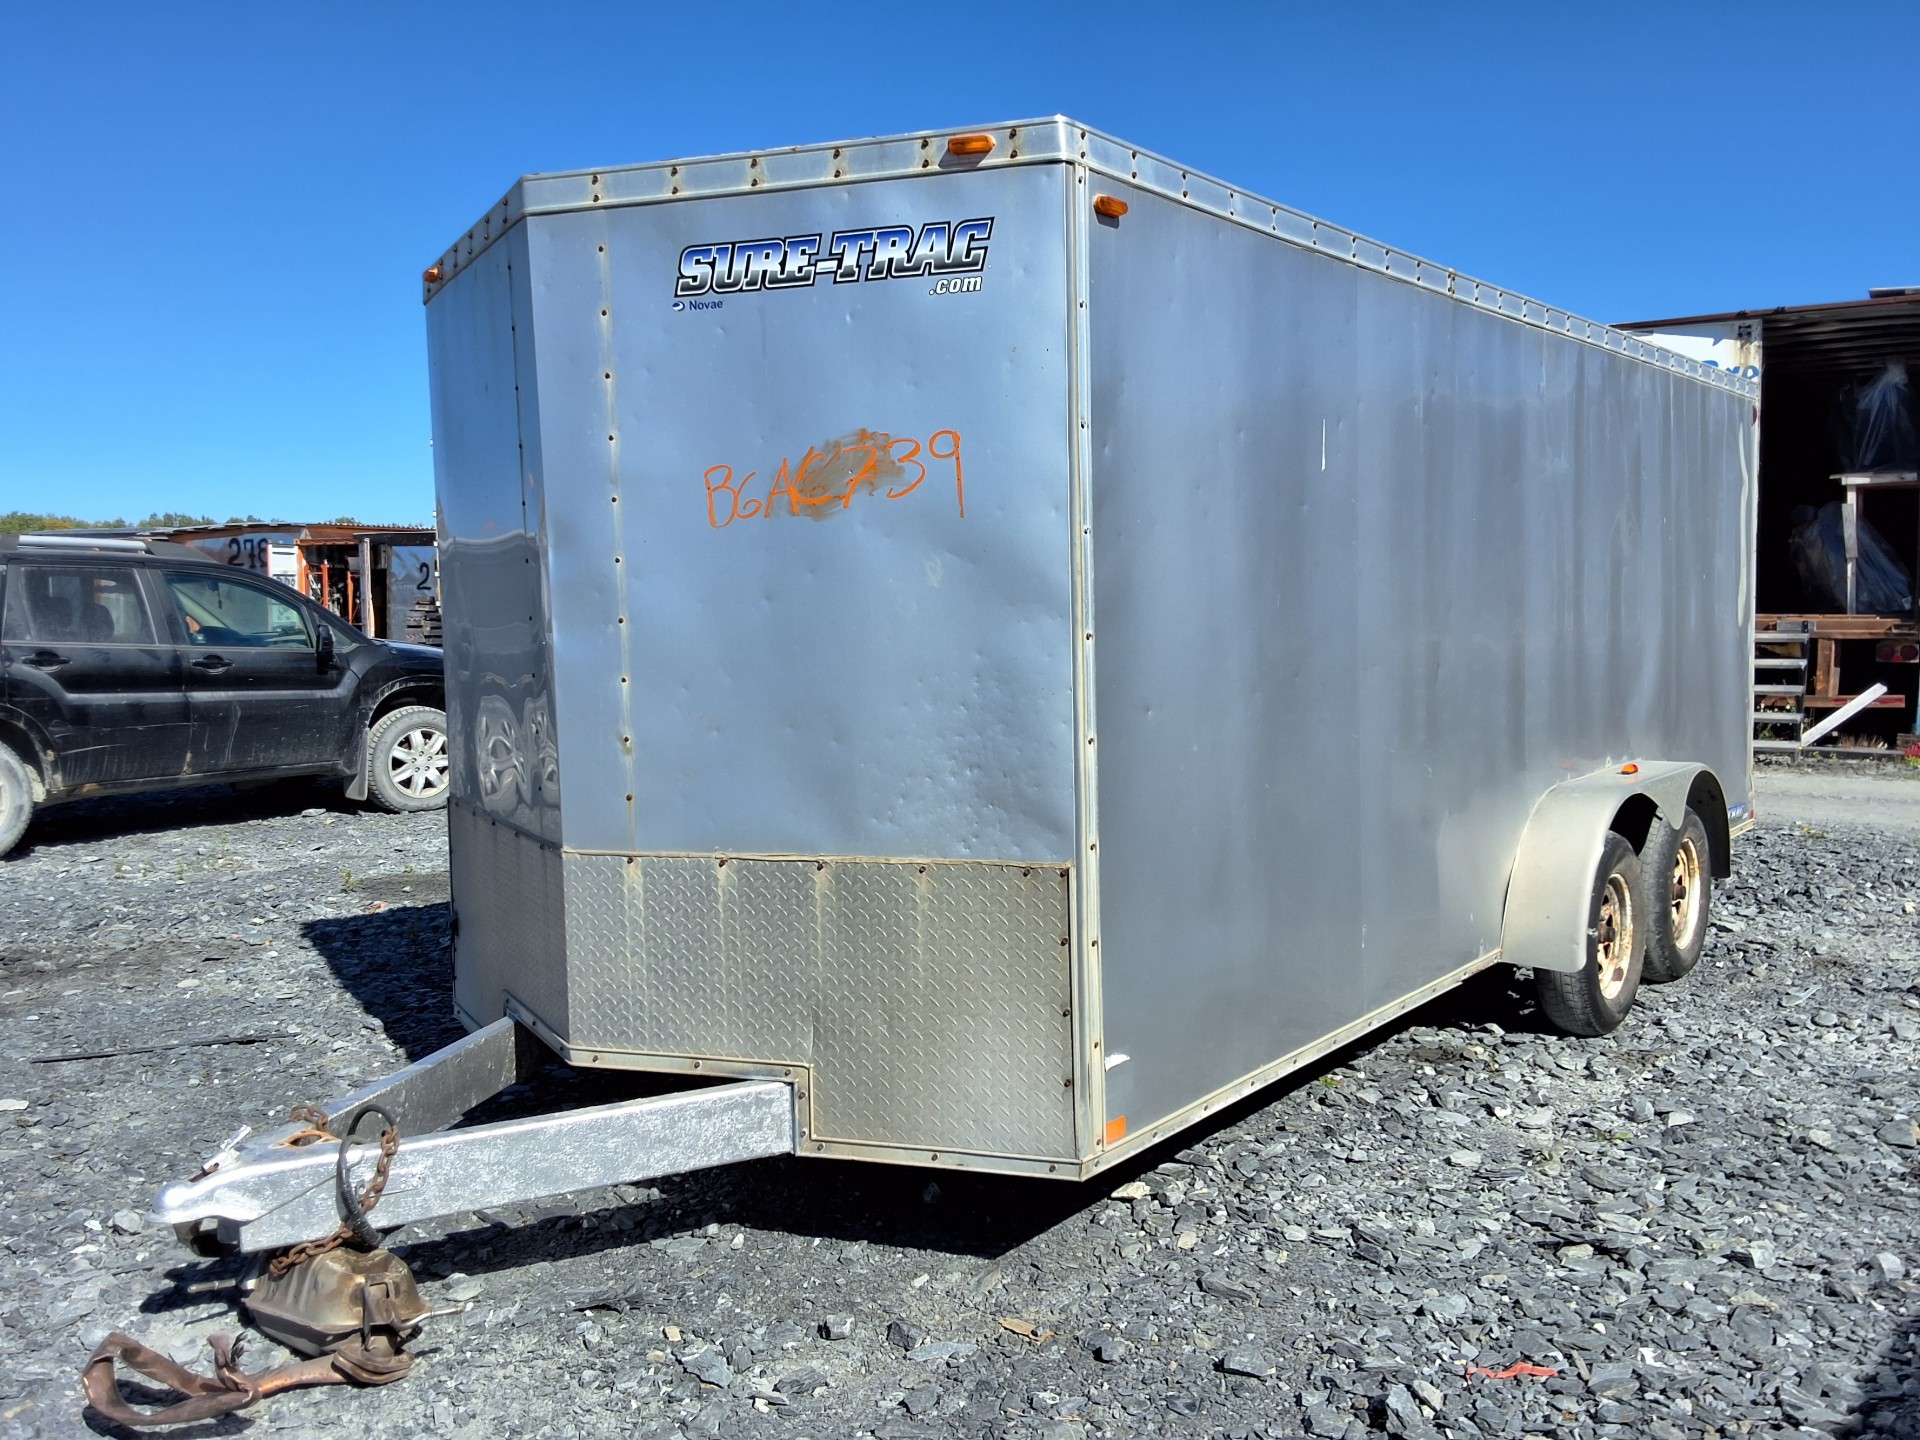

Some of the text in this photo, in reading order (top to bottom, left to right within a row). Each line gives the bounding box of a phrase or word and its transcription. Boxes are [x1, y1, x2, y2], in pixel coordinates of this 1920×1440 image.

[674, 217, 995, 298] SURE-TRAC
[929, 276, 983, 296] .com
[689, 299, 724, 311] Novae
